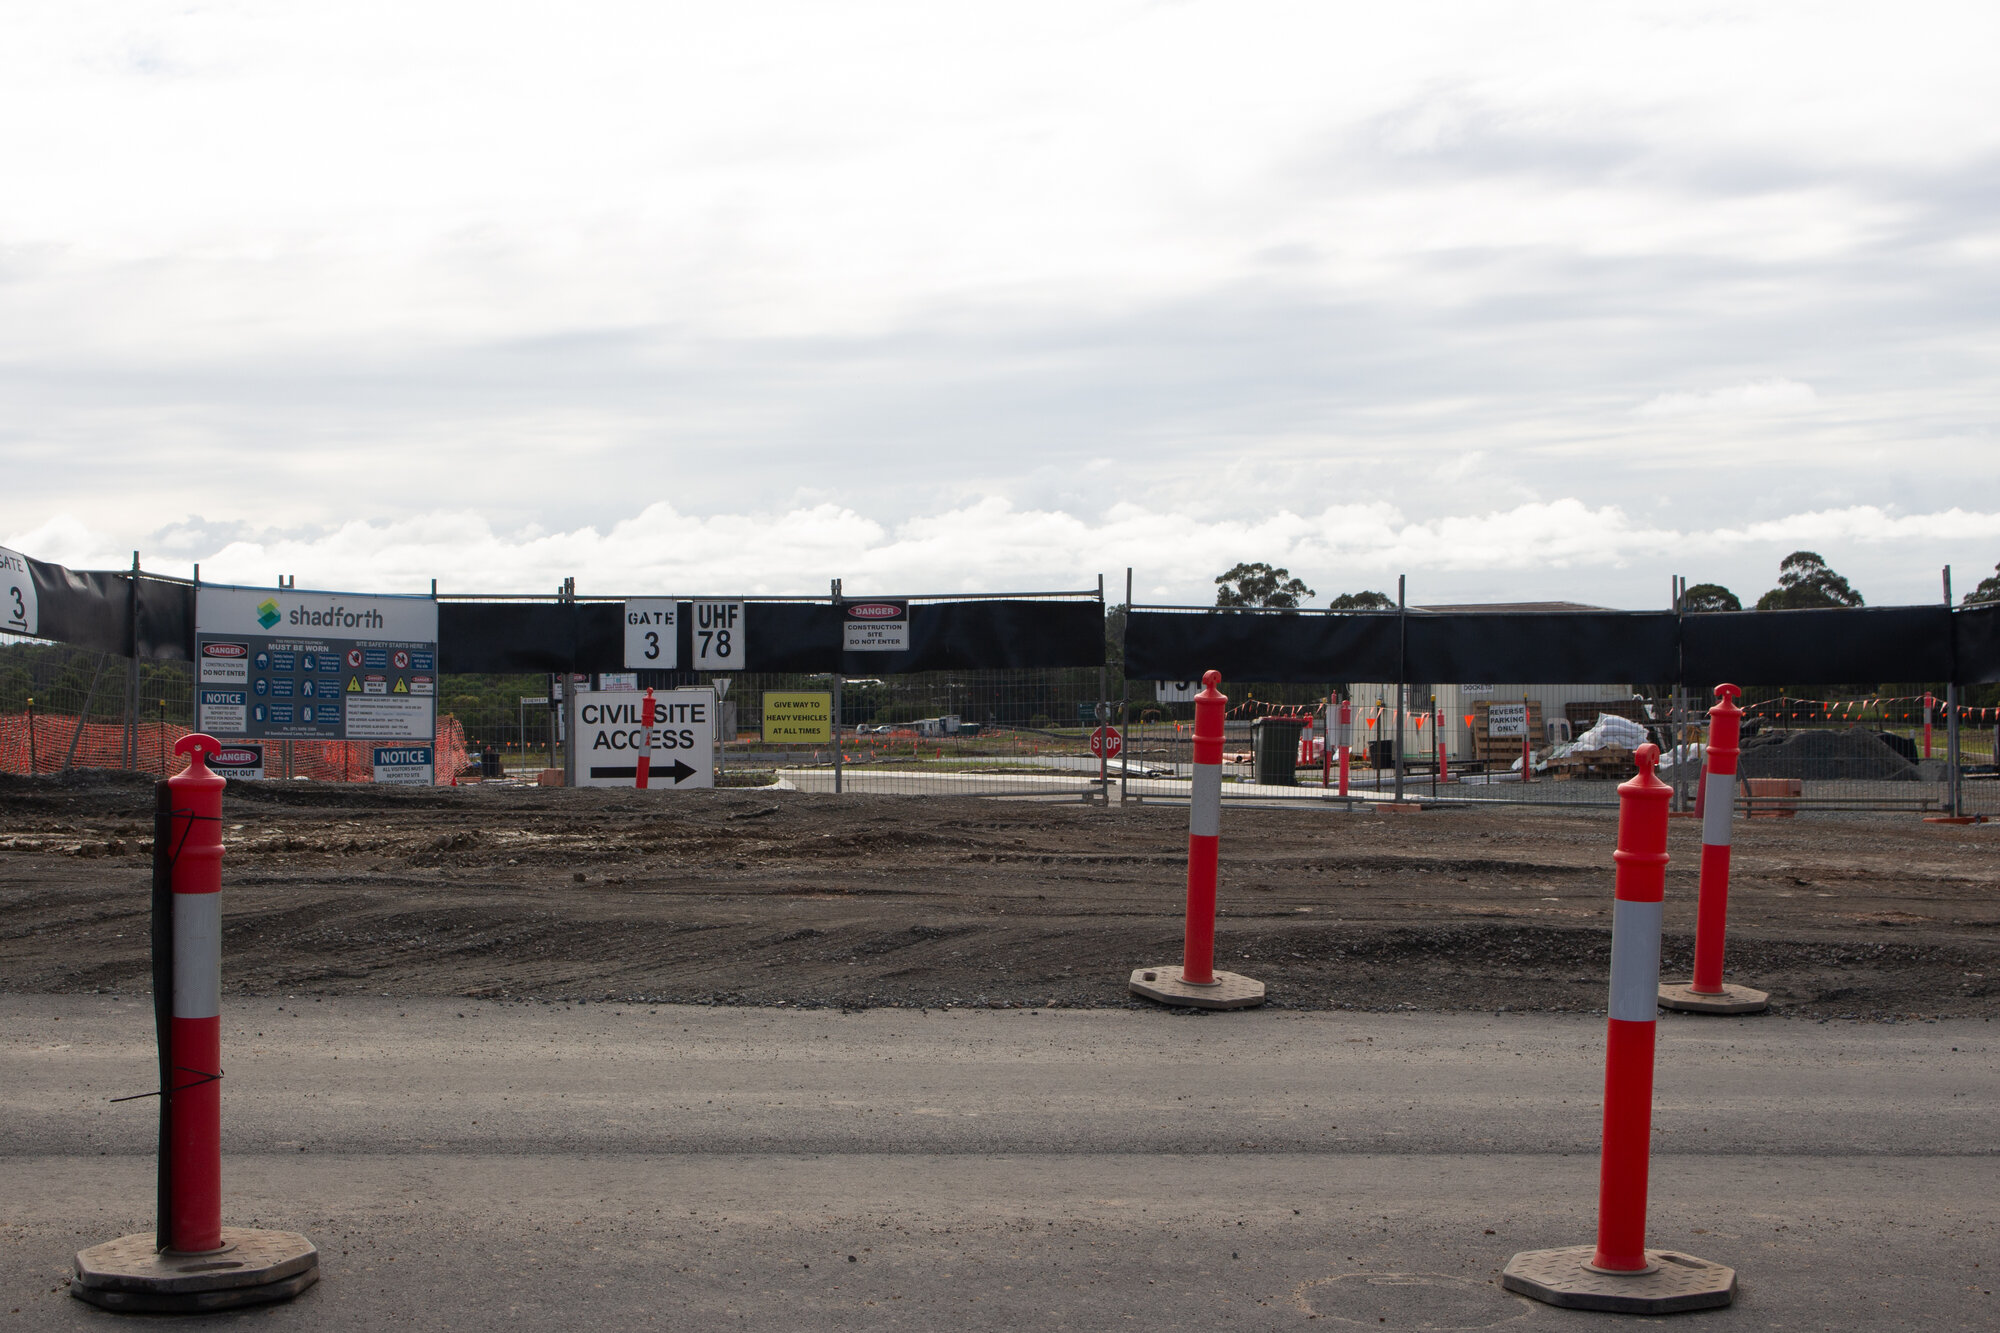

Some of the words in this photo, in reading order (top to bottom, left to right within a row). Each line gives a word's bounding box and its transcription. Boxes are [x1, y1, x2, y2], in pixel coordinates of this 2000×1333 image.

[10, 586, 25, 619] 3
[855, 607, 894, 615] DANGER
[290, 604, 383, 628] shadforth
[628, 612, 674, 625] GATE
[698, 604, 738, 628] UHF
[644, 631, 660, 659] 3
[698, 630, 731, 658] 78
[206, 694, 241, 703] NOTICE
[581, 704, 641, 724] CIVIL
[654, 703, 706, 724] SITE
[1490, 716, 1524, 724] PARKING
[593, 730, 694, 750] ACCESS
[1093, 736, 1120, 749] SOP
[381, 751, 424, 764] NOTICE
